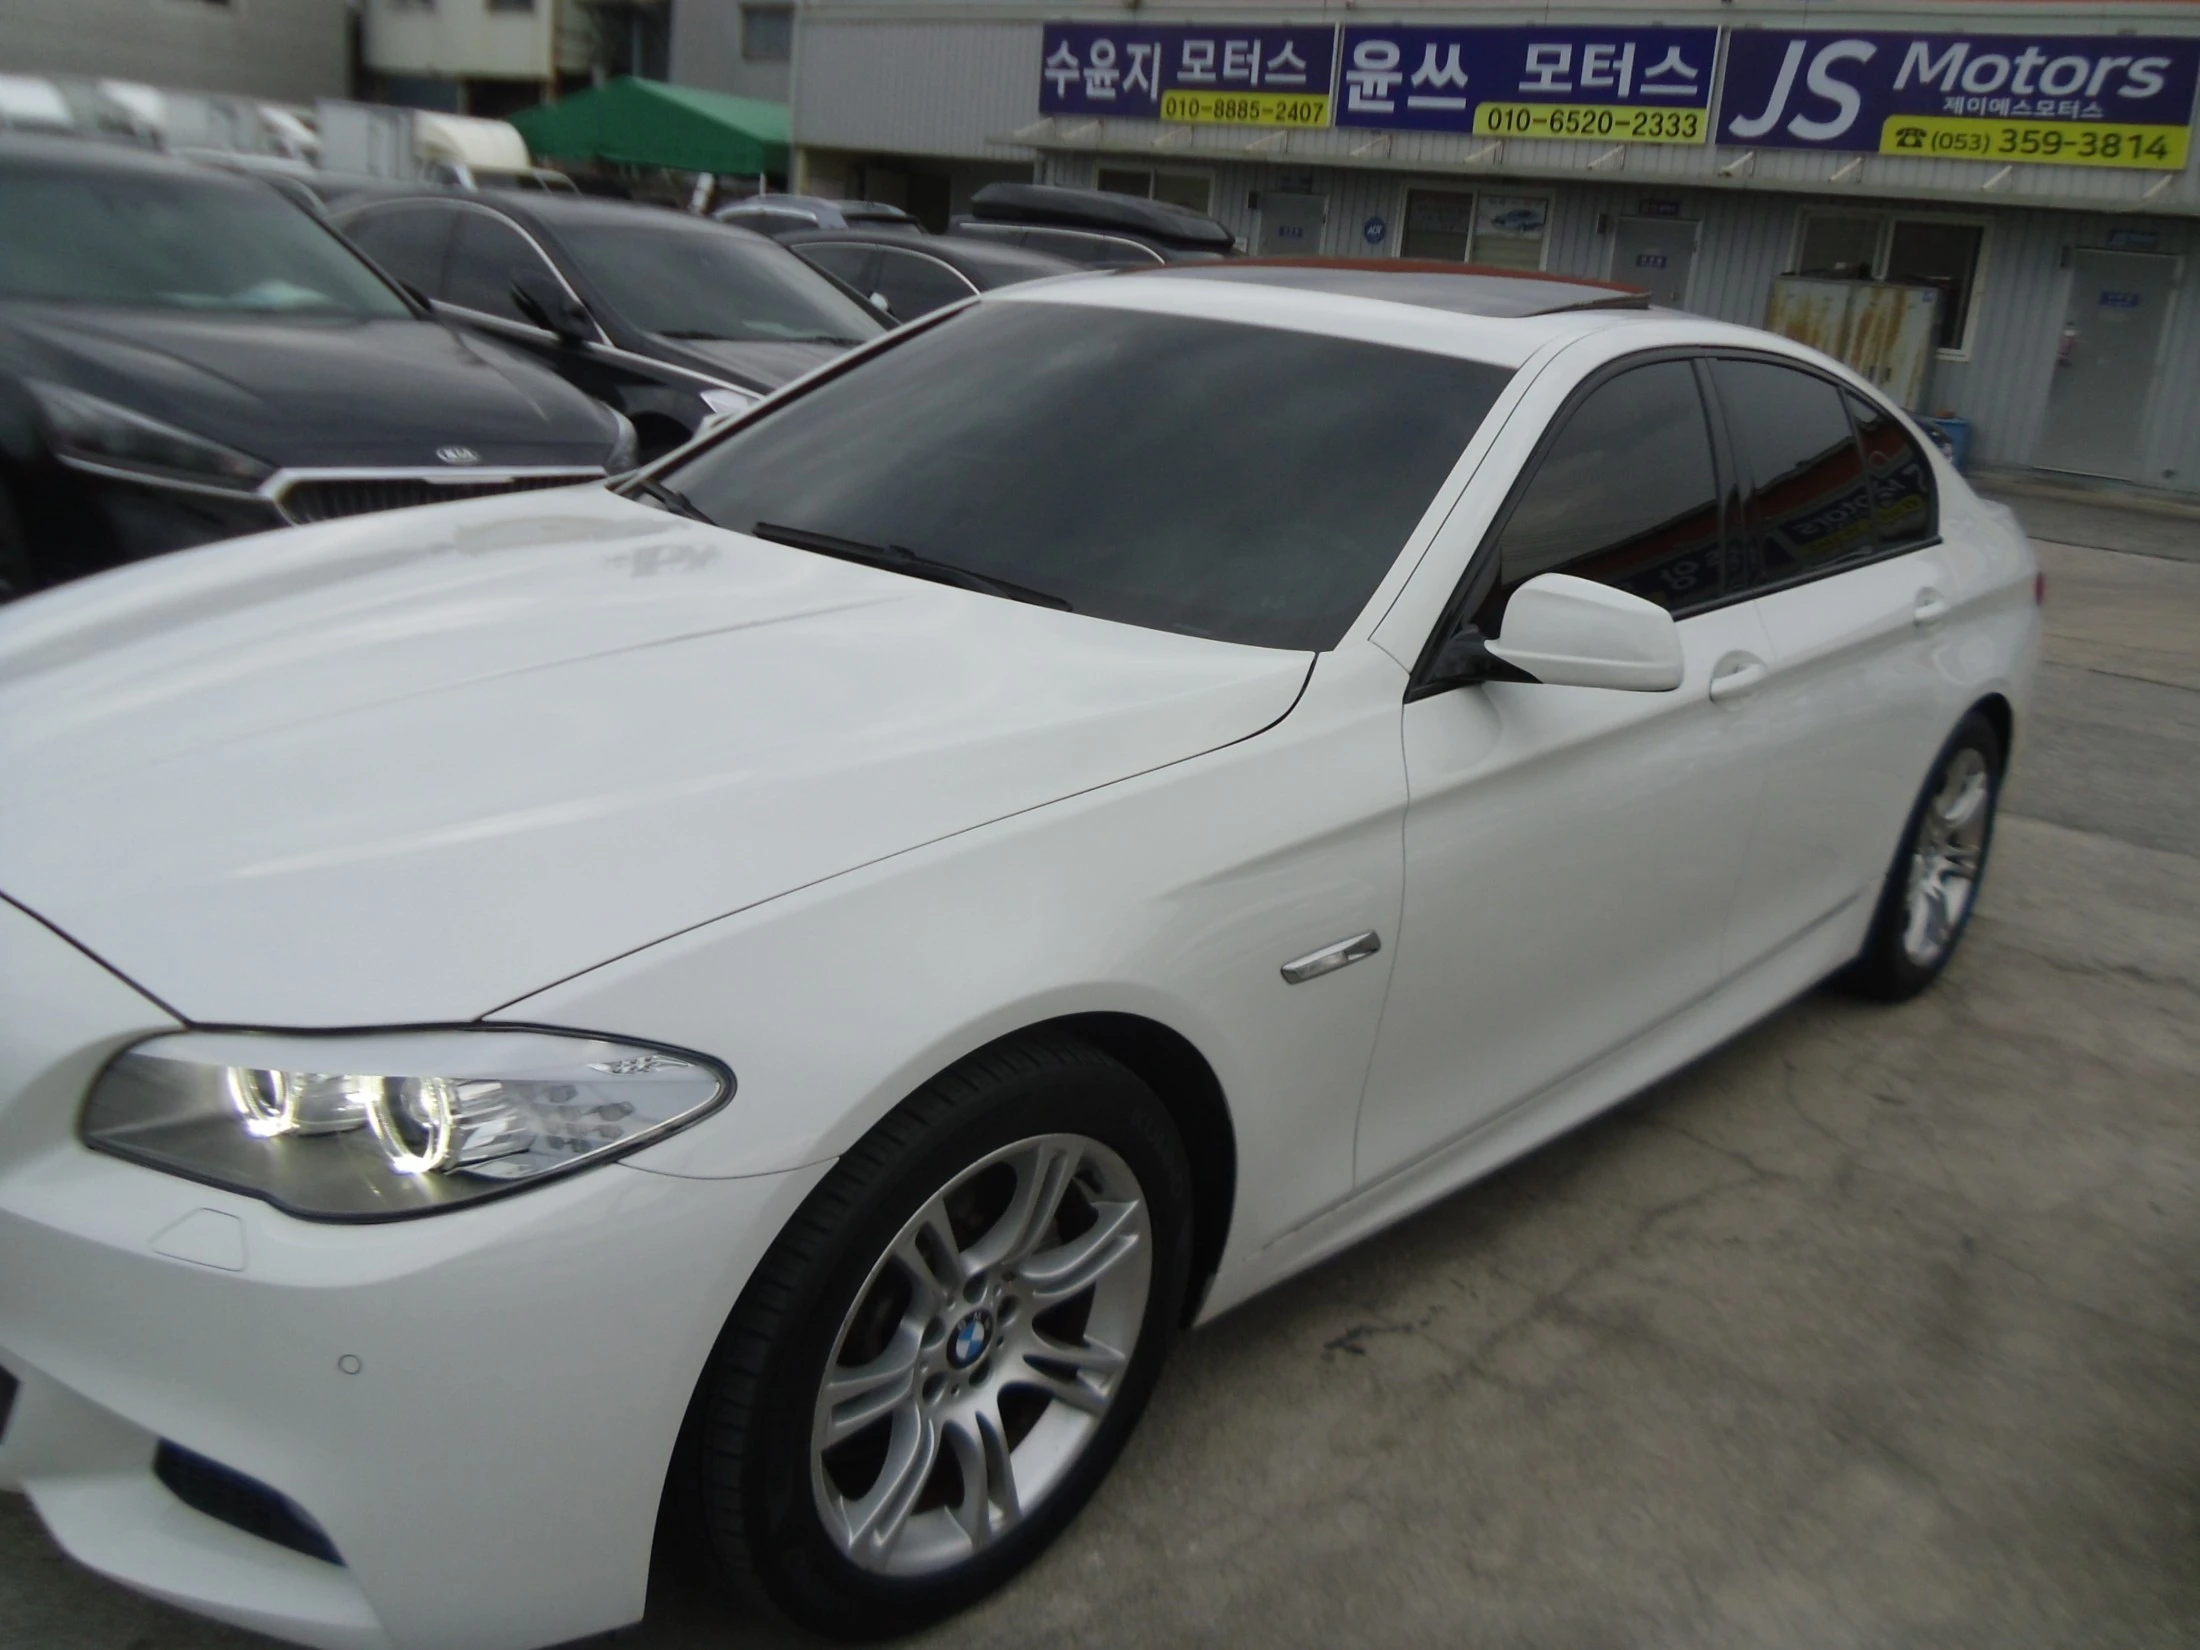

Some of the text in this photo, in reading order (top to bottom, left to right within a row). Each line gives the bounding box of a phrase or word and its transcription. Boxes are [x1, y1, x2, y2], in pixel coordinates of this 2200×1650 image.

[1044, 38, 1308, 103] 수윤지 모터스
[1345, 39, 1699, 114] 윤쓰 모터스
[1728, 39, 2172, 141] JS Motors
[1942, 95, 2106, 120] 제이에스모터스
[1165, 96, 1326, 123] 010-8885-2407
[1487, 107, 1698, 139] 010-6520-2333
[1930, 127, 2169, 162] (053) 359-3814
